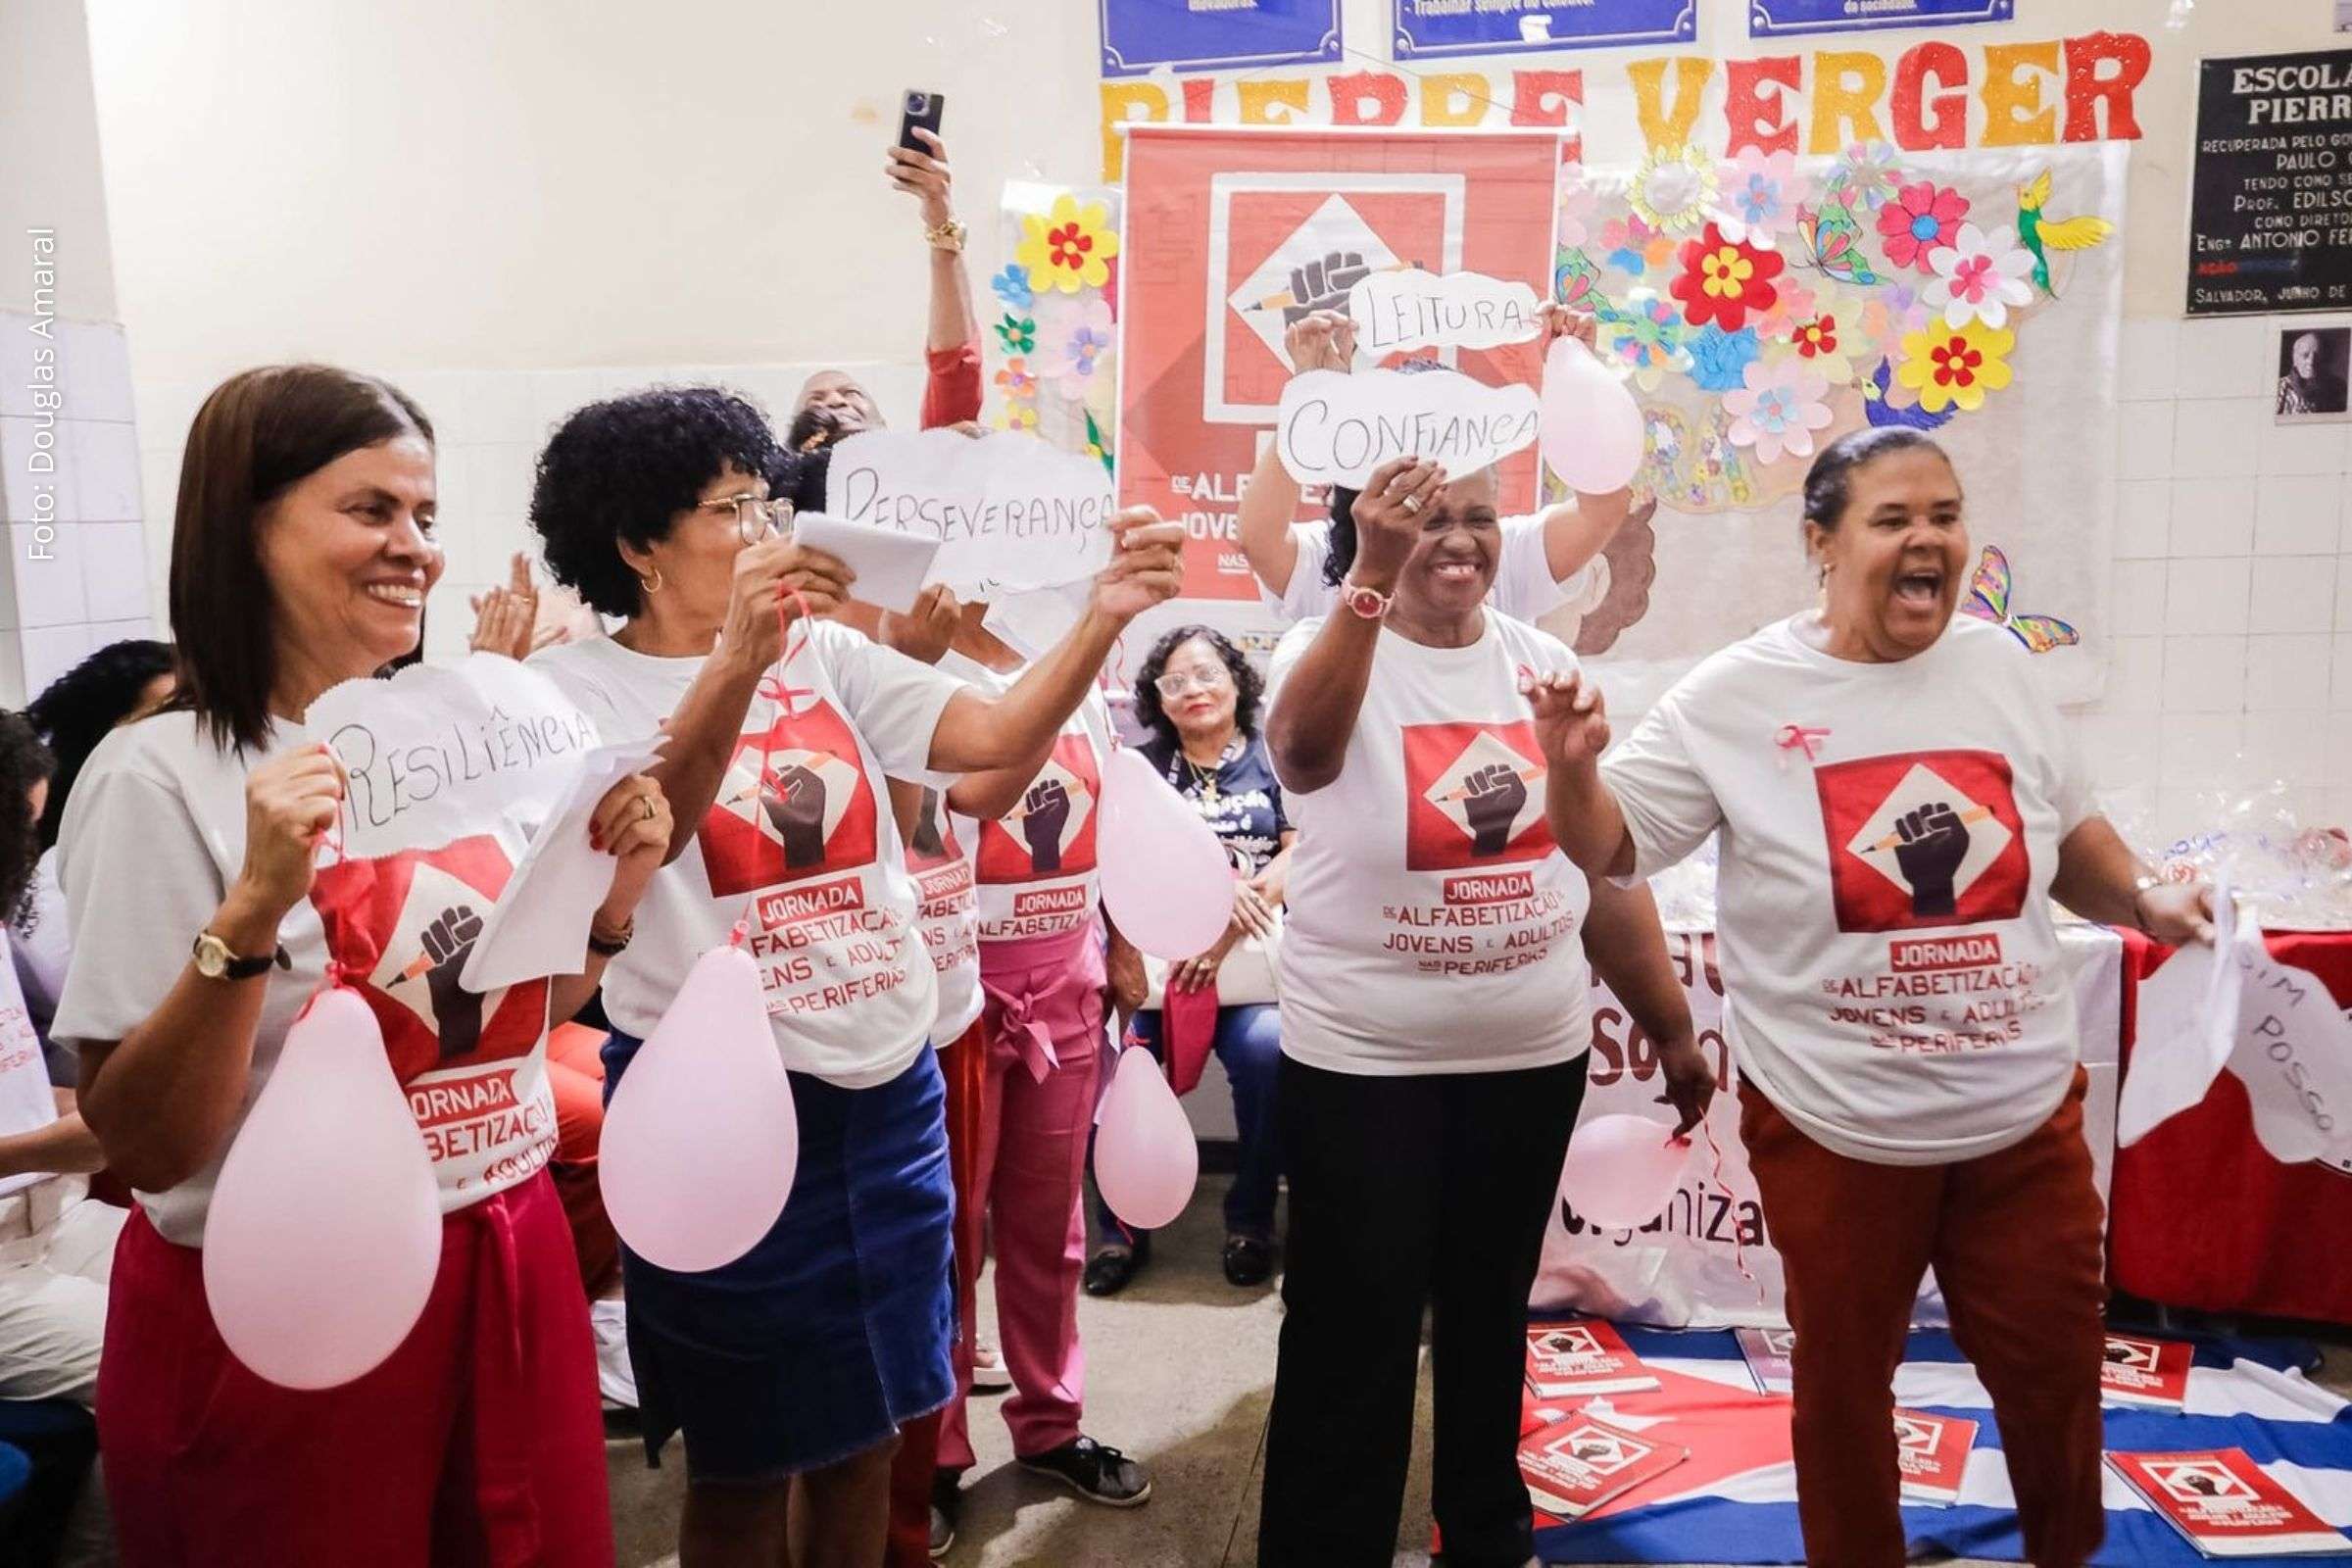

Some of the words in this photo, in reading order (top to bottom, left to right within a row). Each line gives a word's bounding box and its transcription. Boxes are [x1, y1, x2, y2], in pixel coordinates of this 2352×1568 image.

[1627, 30, 2152, 158] VERGER
[2202, 136, 2287, 153] RECUPERADA
[2291, 135, 2326, 148] PELO
[2276, 151, 2335, 171] PAULO
[2244, 177, 2287, 191] TENDO
[2293, 174, 2332, 188] COMO
[2254, 216, 2293, 229] COMO
[2300, 212, 2352, 226] DIRETO
[2239, 228, 2320, 249] ANTONIO
[2278, 286, 2321, 300] JUNHO
[2329, 285, 2346, 298] DE
[1366, 287, 1523, 349] LEITURA
[1288, 399, 1540, 471] CONFIANÇA
[846, 466, 1116, 555] PERSEVERANÇA
[329, 708, 592, 832] RESILIÊNCIA
[1446, 875, 1532, 900] JORNADA
[762, 884, 859, 924] JORNADA
[1016, 891, 1084, 913] JORNADA
[1398, 891, 1558, 927] ALFABETIZAÇÃO
[1383, 932, 1473, 954] JOVENS
[1504, 909, 1574, 950] ADULTOS
[1893, 940, 2000, 966] JORNADA
[1830, 1005, 1927, 1027] JOVENS
[409, 1077, 513, 1122] ORNADA
